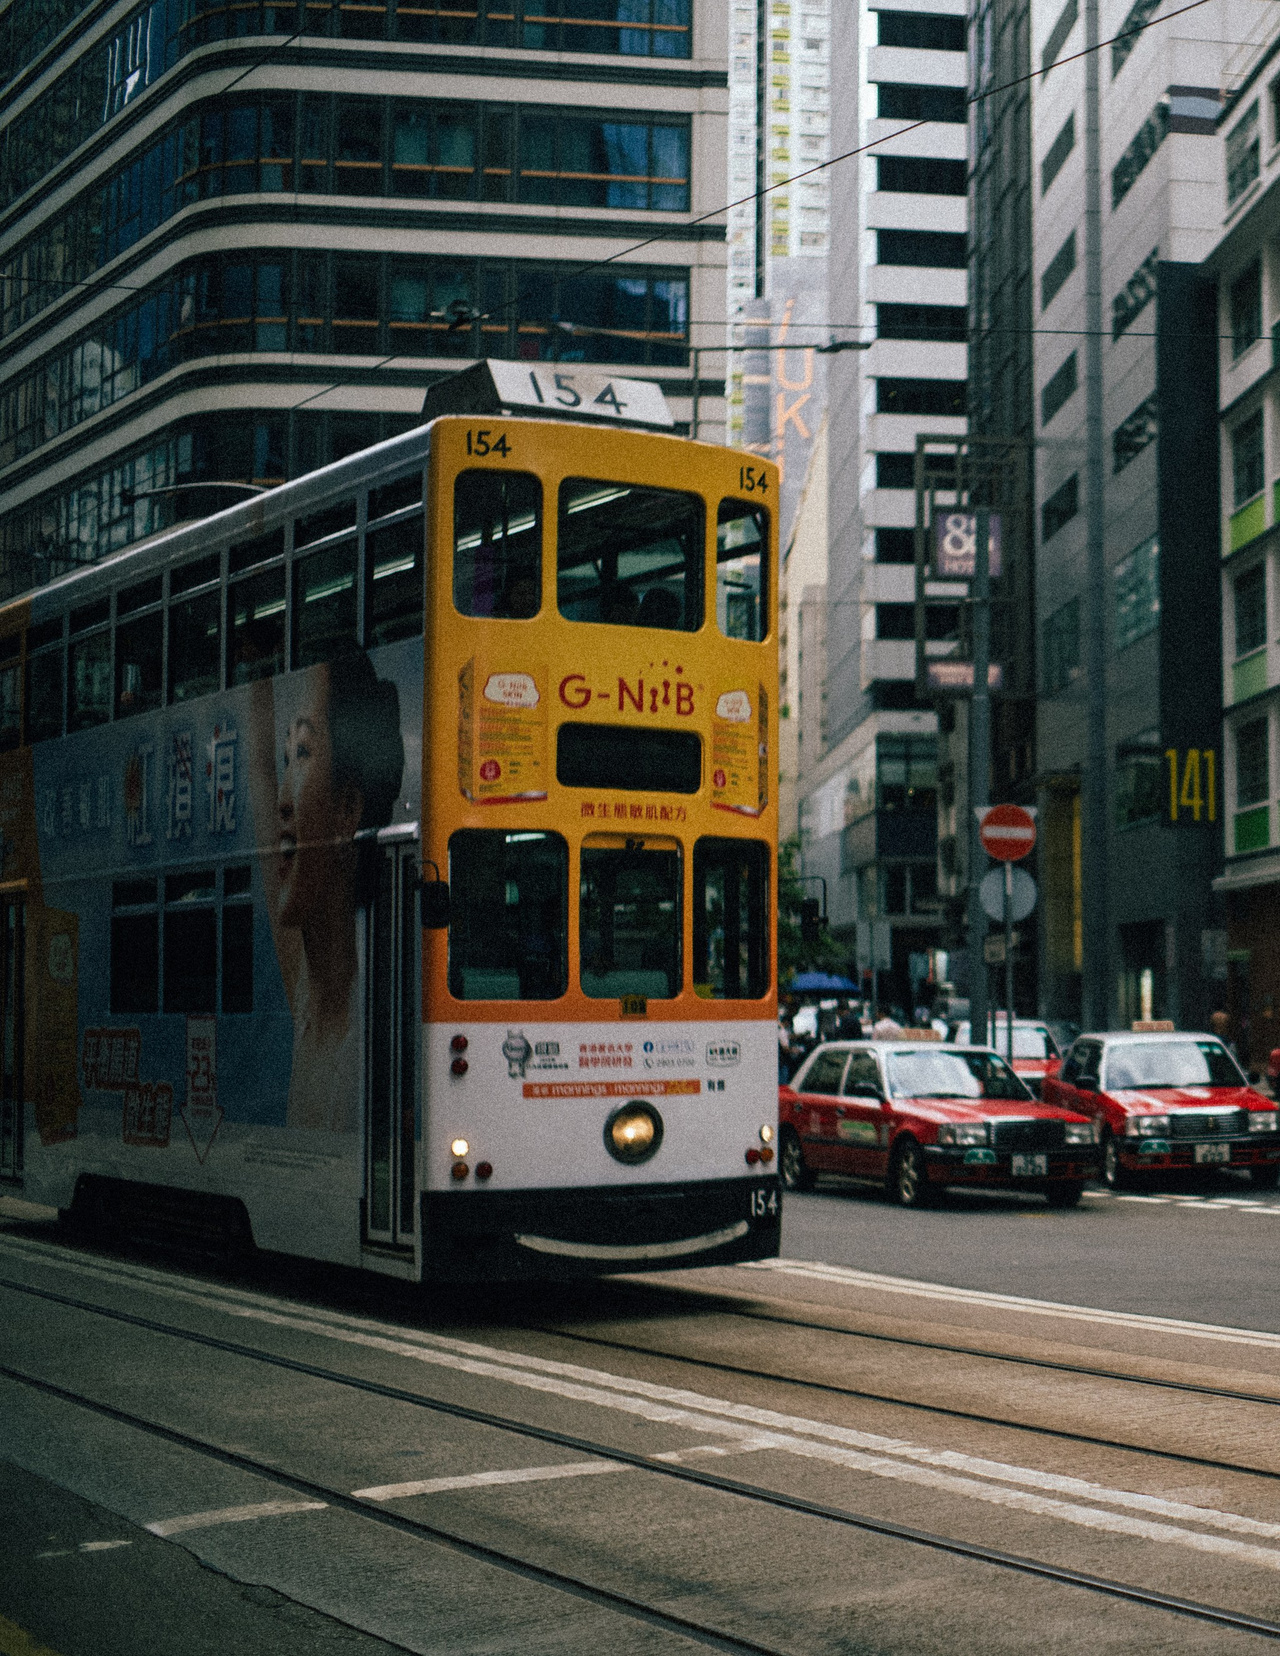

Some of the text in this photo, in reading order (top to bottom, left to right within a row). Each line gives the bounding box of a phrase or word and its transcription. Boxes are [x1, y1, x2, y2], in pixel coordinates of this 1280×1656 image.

[529, 370, 628, 415] 154
[466, 429, 512, 458] 154
[739, 466, 769, 494] 154
[1164, 748, 1217, 822] 141
[750, 1189, 778, 1217] 154
